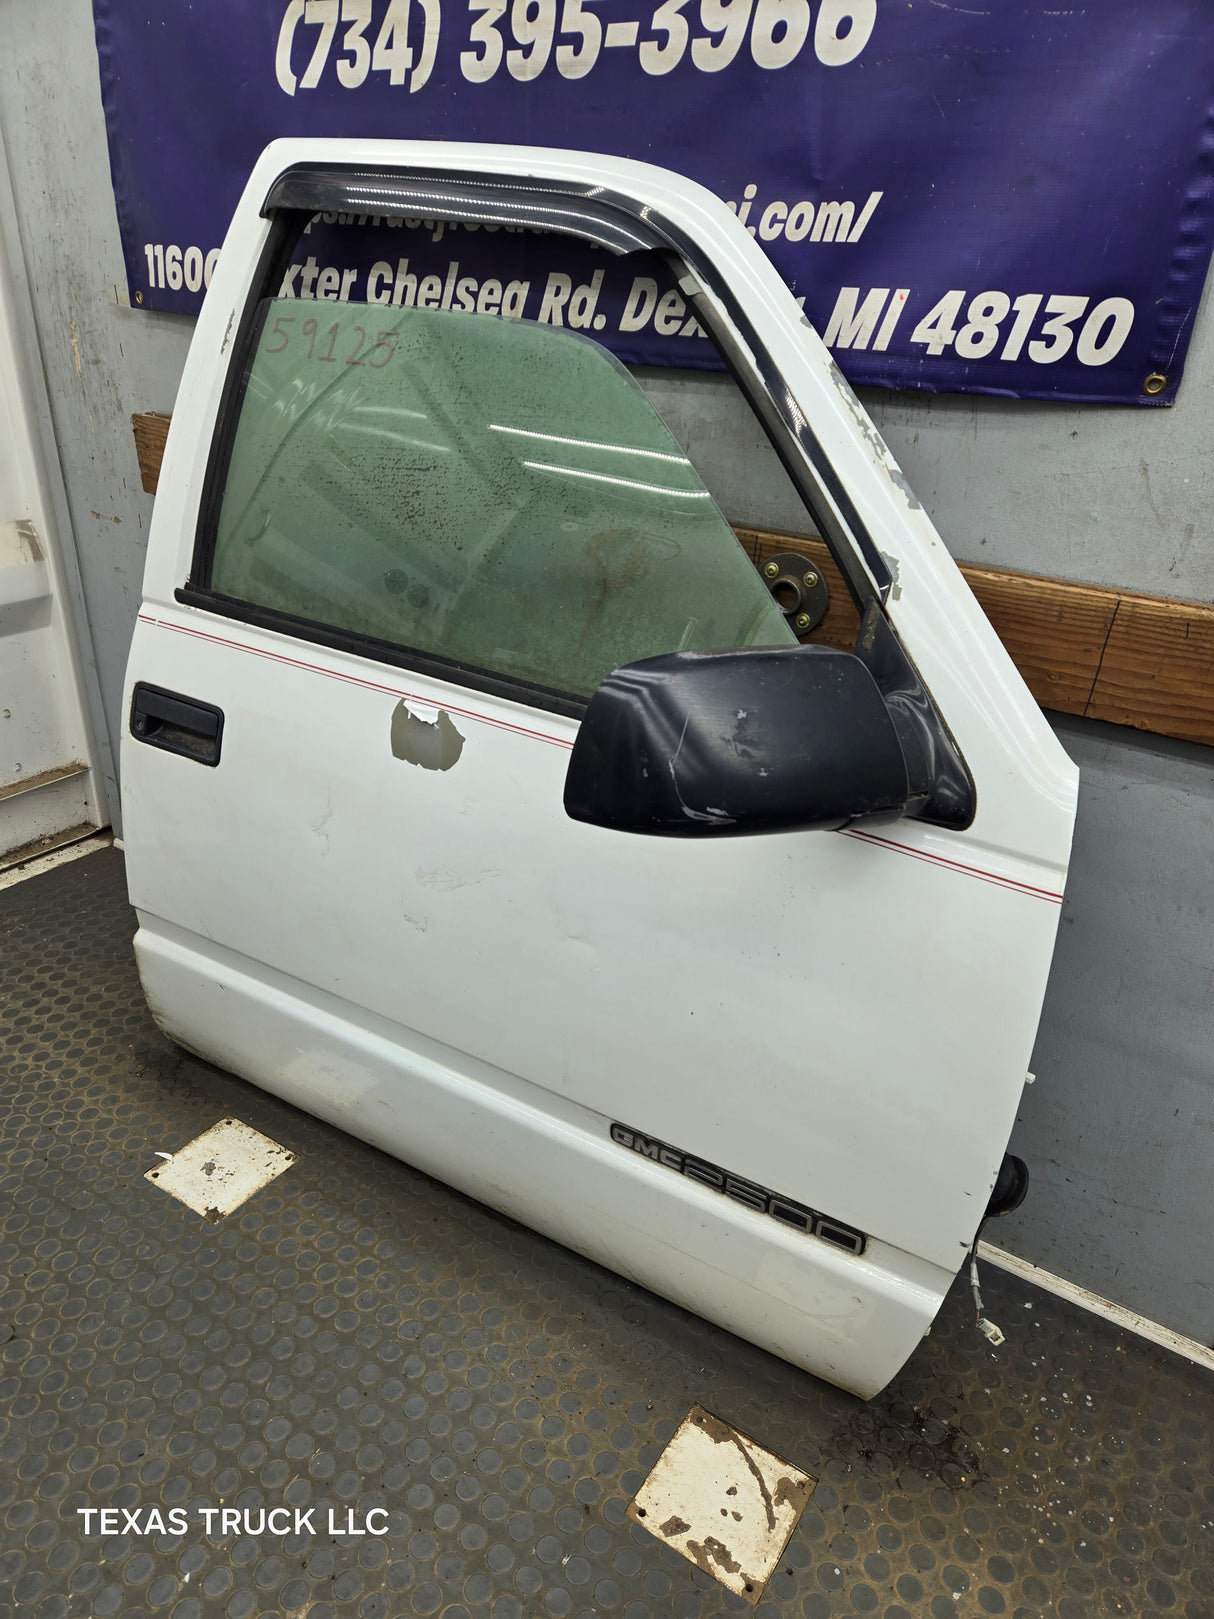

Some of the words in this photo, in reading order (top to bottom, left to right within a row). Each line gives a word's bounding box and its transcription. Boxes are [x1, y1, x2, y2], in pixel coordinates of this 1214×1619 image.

[275, 0, 441, 96] (734)
[460, 0, 877, 84] 395-3966
[265, 315, 399, 368] 59125
[366, 258, 531, 321] Chelsea
[538, 269, 607, 331] Rd.
[822, 286, 911, 351] MI
[910, 290, 1135, 366] 48130
